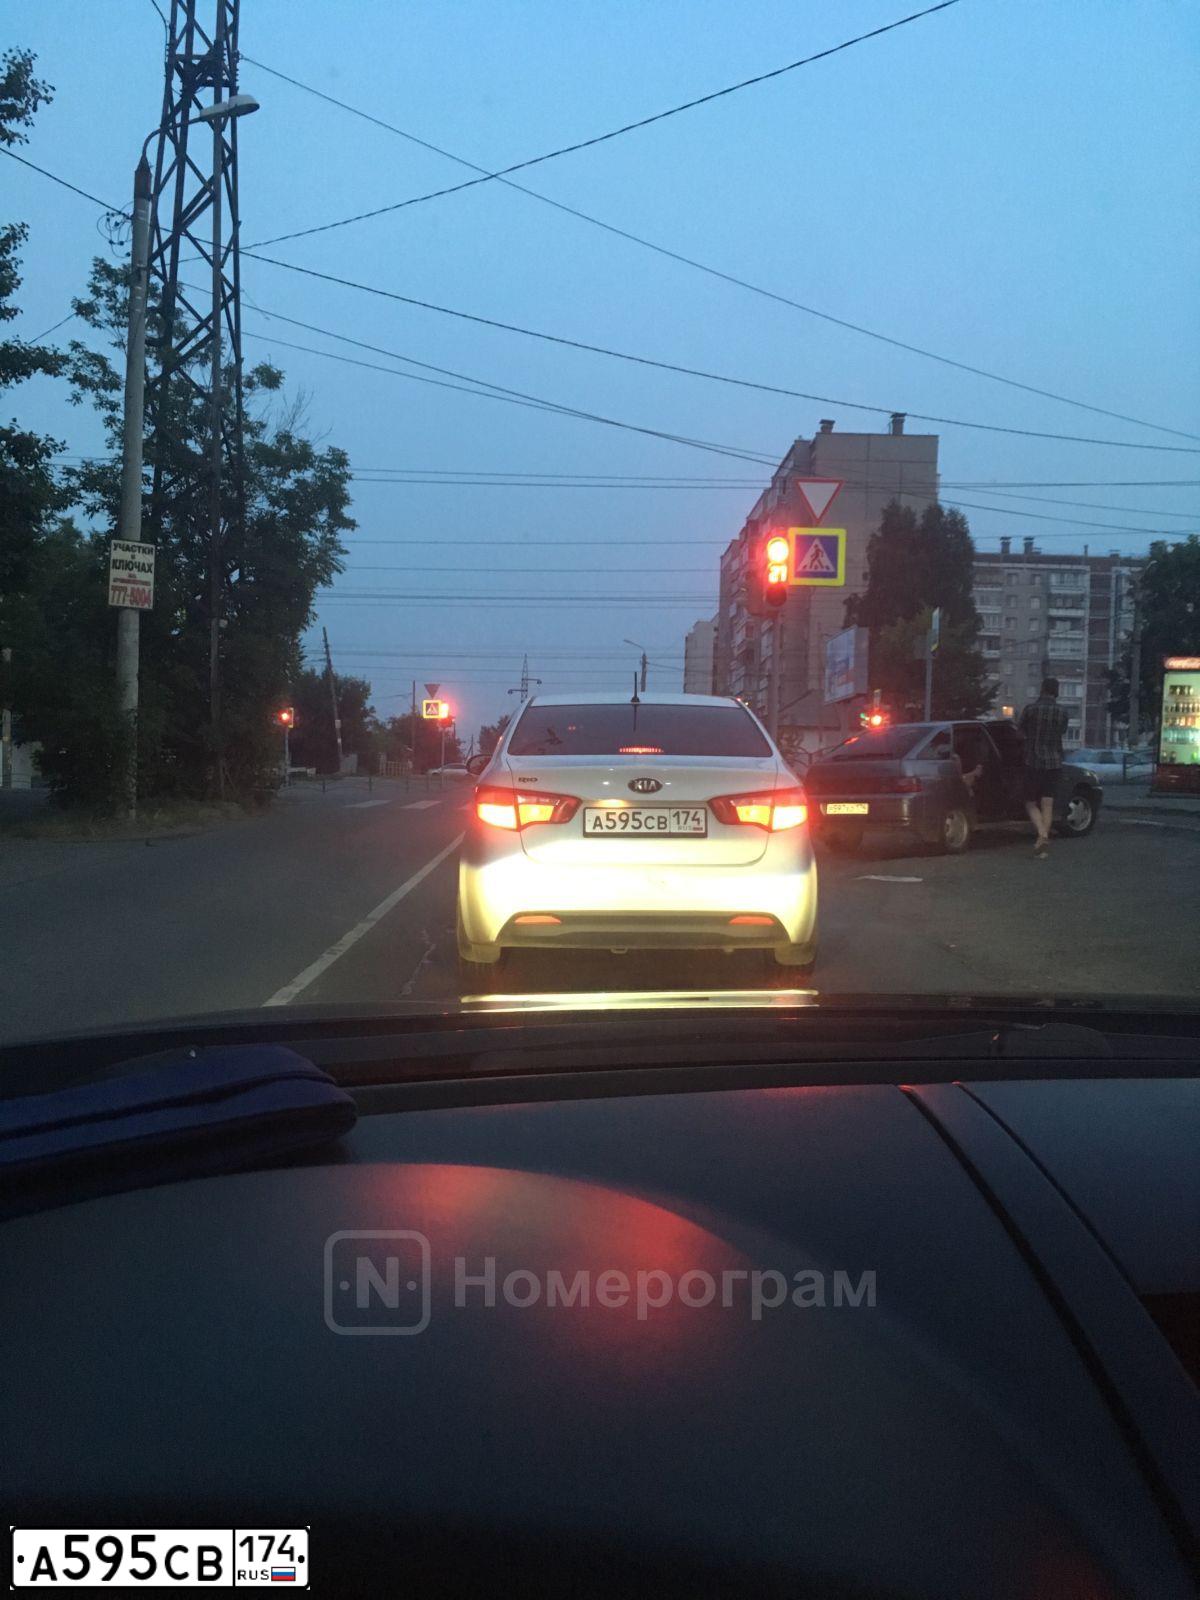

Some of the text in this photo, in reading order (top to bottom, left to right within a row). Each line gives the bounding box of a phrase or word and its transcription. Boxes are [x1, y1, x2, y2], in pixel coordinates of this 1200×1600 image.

[113, 542, 154, 555] УЧАСТКИ
[112, 559, 153, 573] КЛЮЧАХ
[634, 779, 657, 790] KIA
[592, 811, 701, 831] А595СВ 174
